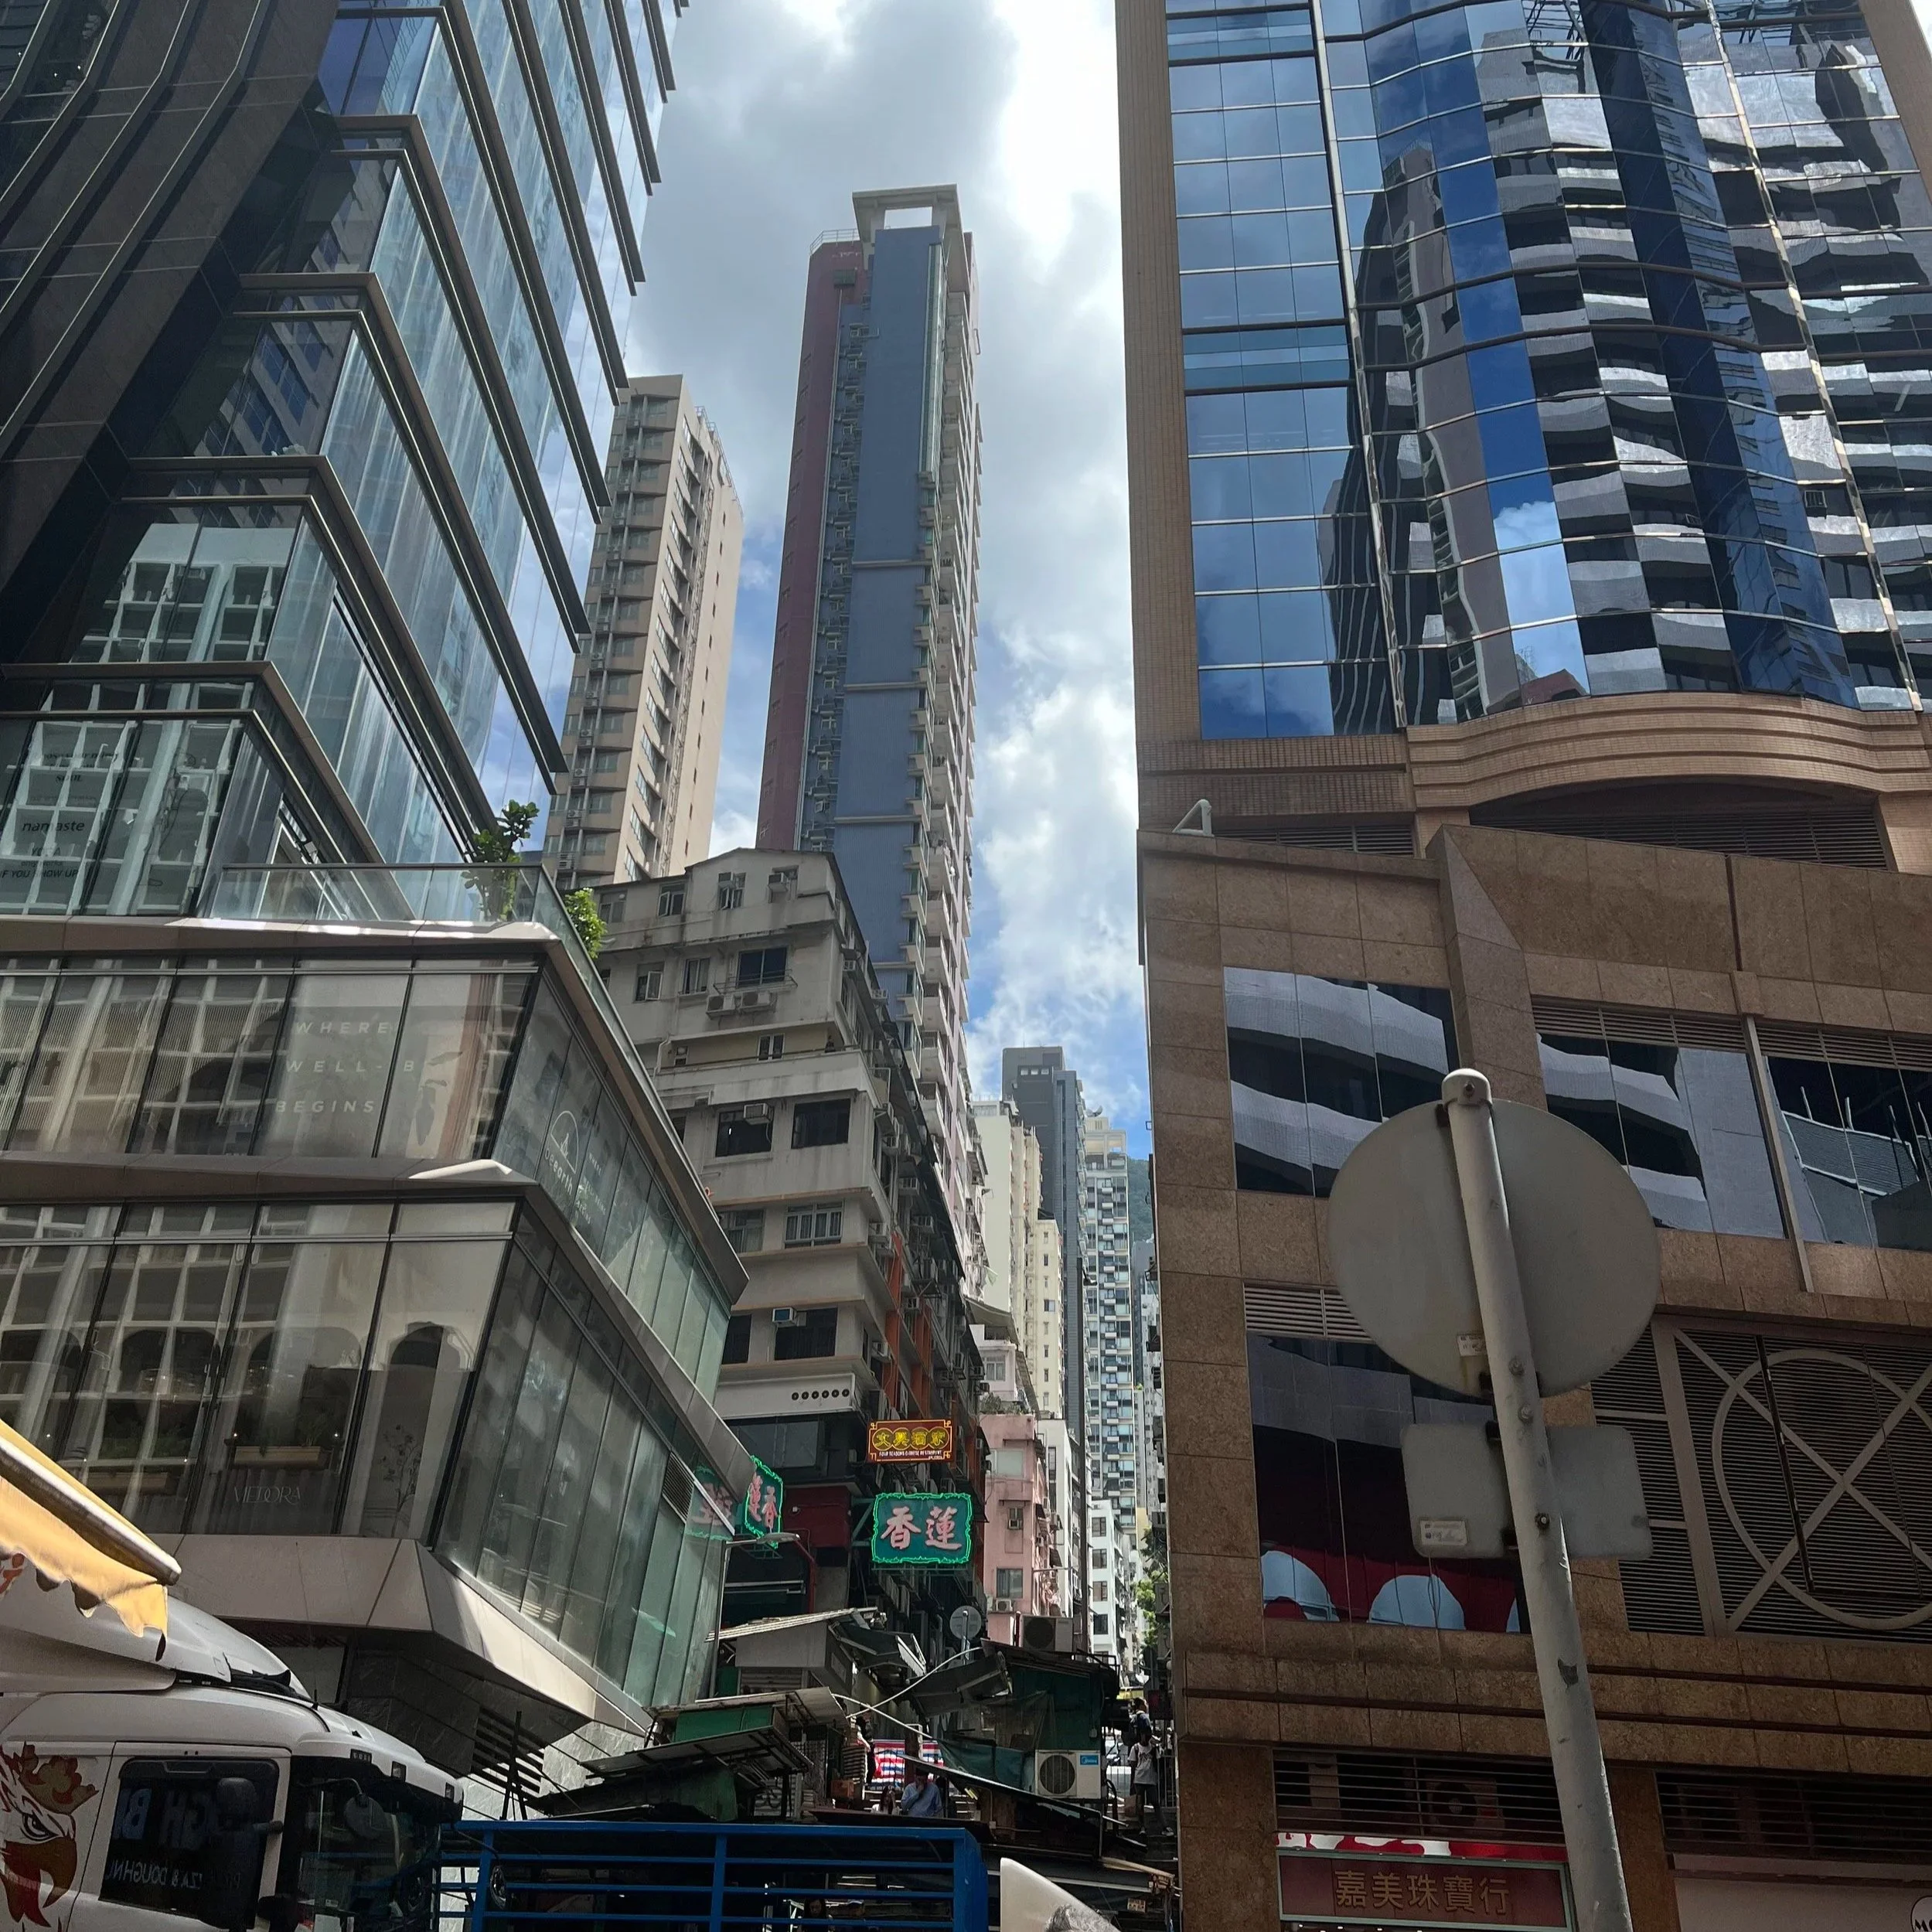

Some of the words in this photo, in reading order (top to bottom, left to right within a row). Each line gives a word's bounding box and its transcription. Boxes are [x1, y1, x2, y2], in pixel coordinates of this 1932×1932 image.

[22, 821, 84, 831] namaste
[32, 847, 61, 856] YOA
[12, 870, 31, 878] YOU
[296, 1022, 389, 1034] WHERE
[274, 1100, 375, 1113] BEGINS
[1335, 1869, 1510, 1915] 嘉美珠寶行
